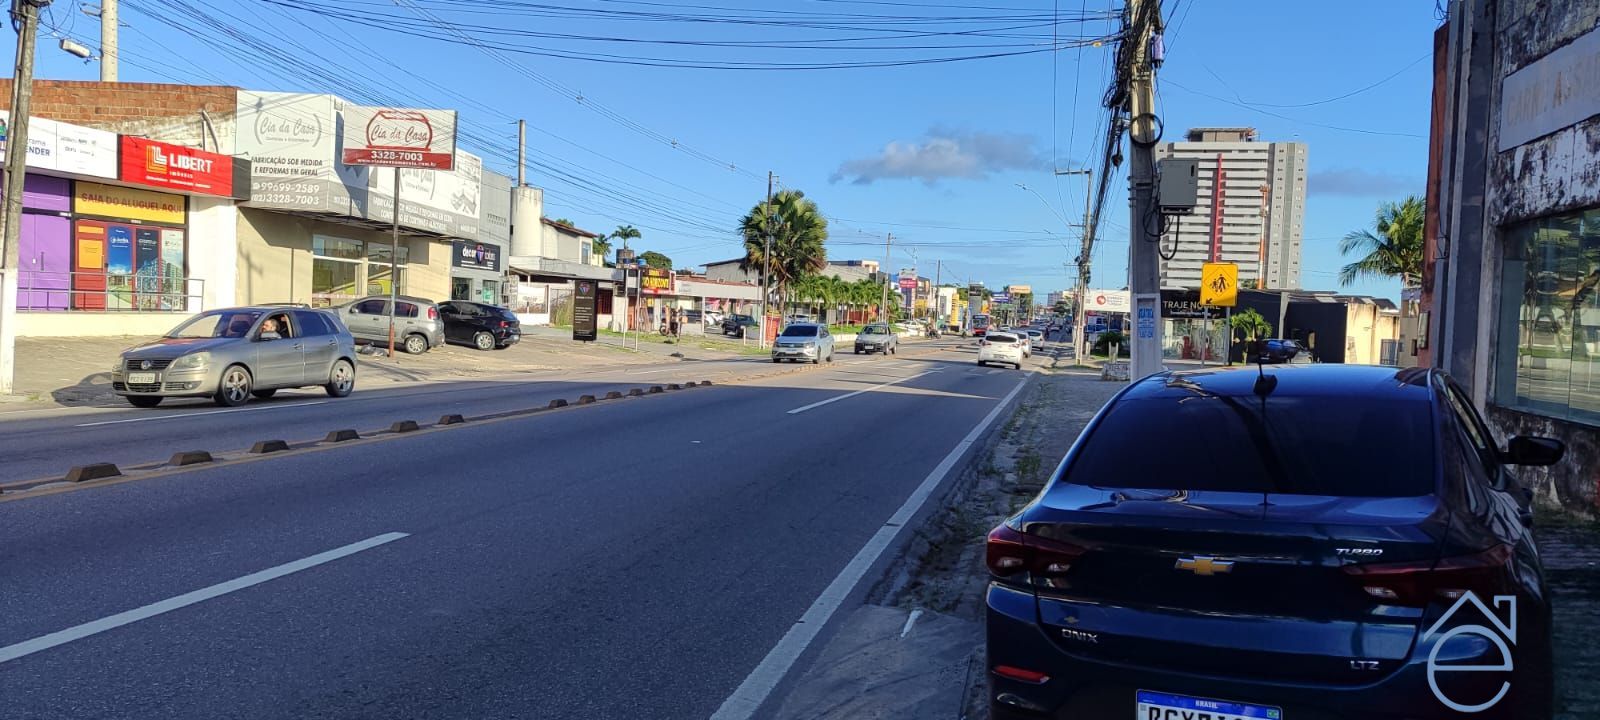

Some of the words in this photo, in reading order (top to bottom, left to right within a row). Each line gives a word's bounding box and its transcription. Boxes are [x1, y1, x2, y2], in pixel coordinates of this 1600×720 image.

[260, 117, 276, 135] Cia
[279, 119, 290, 133] da
[293, 118, 316, 136] Casa
[371, 125, 387, 141] Cia
[390, 127, 401, 139] da
[405, 126, 428, 143] Casa
[25, 145, 50, 157] ENDER
[371, 151, 423, 162] 3328-7003
[170, 153, 213, 174] LIBERT
[300, 158, 323, 167] MEDIDA
[254, 166, 258, 174] E
[259, 166, 290, 175] REFORMAS
[290, 167, 299, 176] EM
[300, 168, 319, 176] GERAL
[261, 182, 320, 194] 99699-2589
[82, 192, 104, 203] SAIA
[106, 195, 119, 205] DO
[121, 197, 159, 210] ALUGUEL
[162, 202, 182, 213] AQUI
[1163, 300, 1188, 309] TRAJE
[1336, 547, 1382, 556] TURBO
[1061, 628, 1098, 644] ONIX
[1350, 660, 1381, 669] LTZ
[1195, 699, 1220, 709] BRASIL
